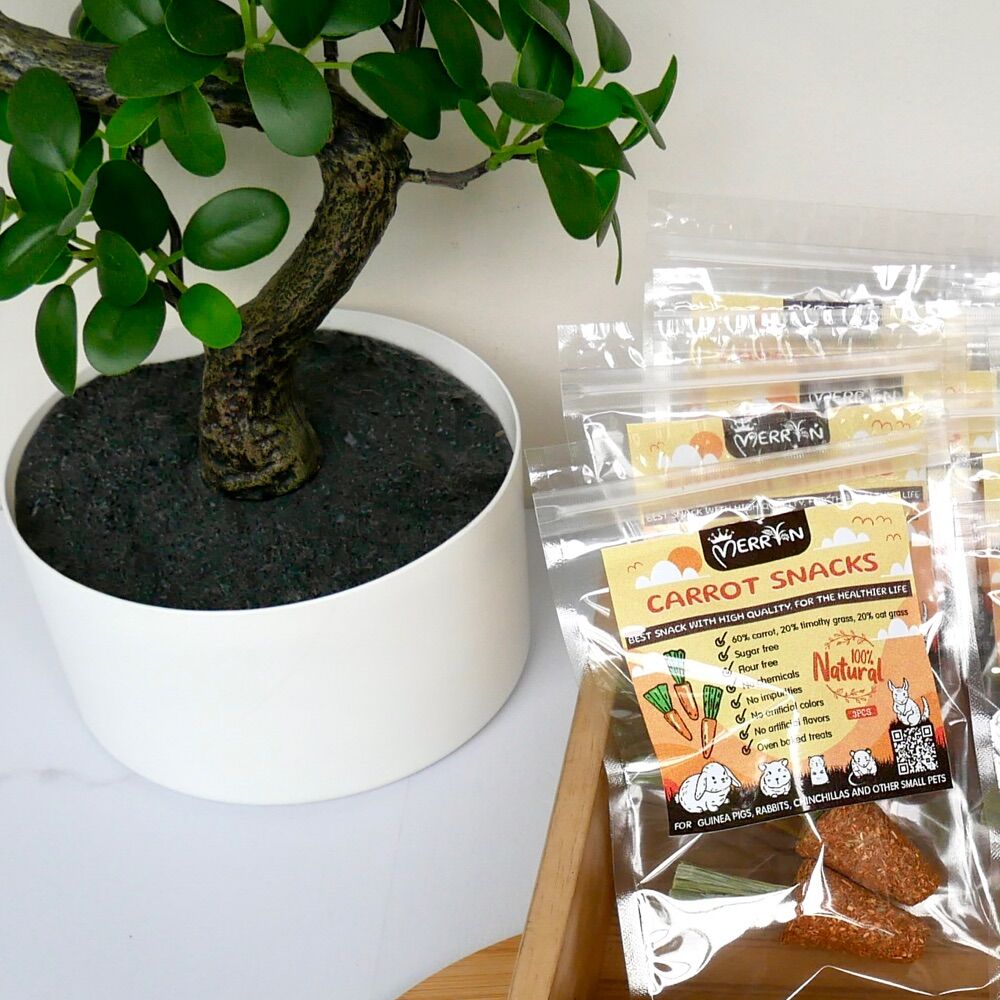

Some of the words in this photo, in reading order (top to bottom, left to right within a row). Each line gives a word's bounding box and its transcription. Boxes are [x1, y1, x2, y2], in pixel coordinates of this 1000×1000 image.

[903, 491, 920, 499] LIFE
[647, 577, 760, 613] CARROT
[770, 553, 879, 589] SNACKS
[628, 631, 651, 645] BEST
[655, 623, 687, 638] SNACK
[688, 617, 717, 630] WITH
[718, 613, 745, 626] HIGH
[794, 598, 814, 609] FOR
[816, 593, 835, 604] THE
[837, 587, 887, 601] HEALTHIER
[888, 584, 908, 595] LIFE
[732, 633, 750, 644] 60%
[751, 627, 778, 640] carrot,
[780, 622, 799, 634] 20%
[800, 617, 830, 630] timothy
[832, 614, 856, 626] grass,
[857, 610, 874, 621] 20%
[875, 609, 887, 619] oat
[889, 608, 909, 620] grass
[734, 648, 760, 662] Sugar
[762, 643, 779, 653] free
[851, 648, 874, 665] 100%
[738, 664, 759, 674] Flour
[761, 659, 779, 669] free
[757, 669, 800, 684] hemicals
[813, 651, 885, 684] Natural
[746, 695, 759, 705] No
[751, 710, 764, 720] No
[765, 702, 798, 717] artificial
[800, 698, 824, 709] colors
[754, 726, 767, 736] No
[802, 714, 830, 726] flavors
[757, 740, 778, 751] Oven
[808, 730, 832, 741] treats
[674, 820, 692, 831] FOR
[697, 815, 731, 827] GUINEA
[732, 810, 754, 824] PIGS,
[755, 802, 792, 816] RABBITS,
[851, 785, 871, 797] AND
[872, 781, 899, 793] OTHER
[901, 777, 926, 788] SMALL
[928, 773, 947, 784] PETS
